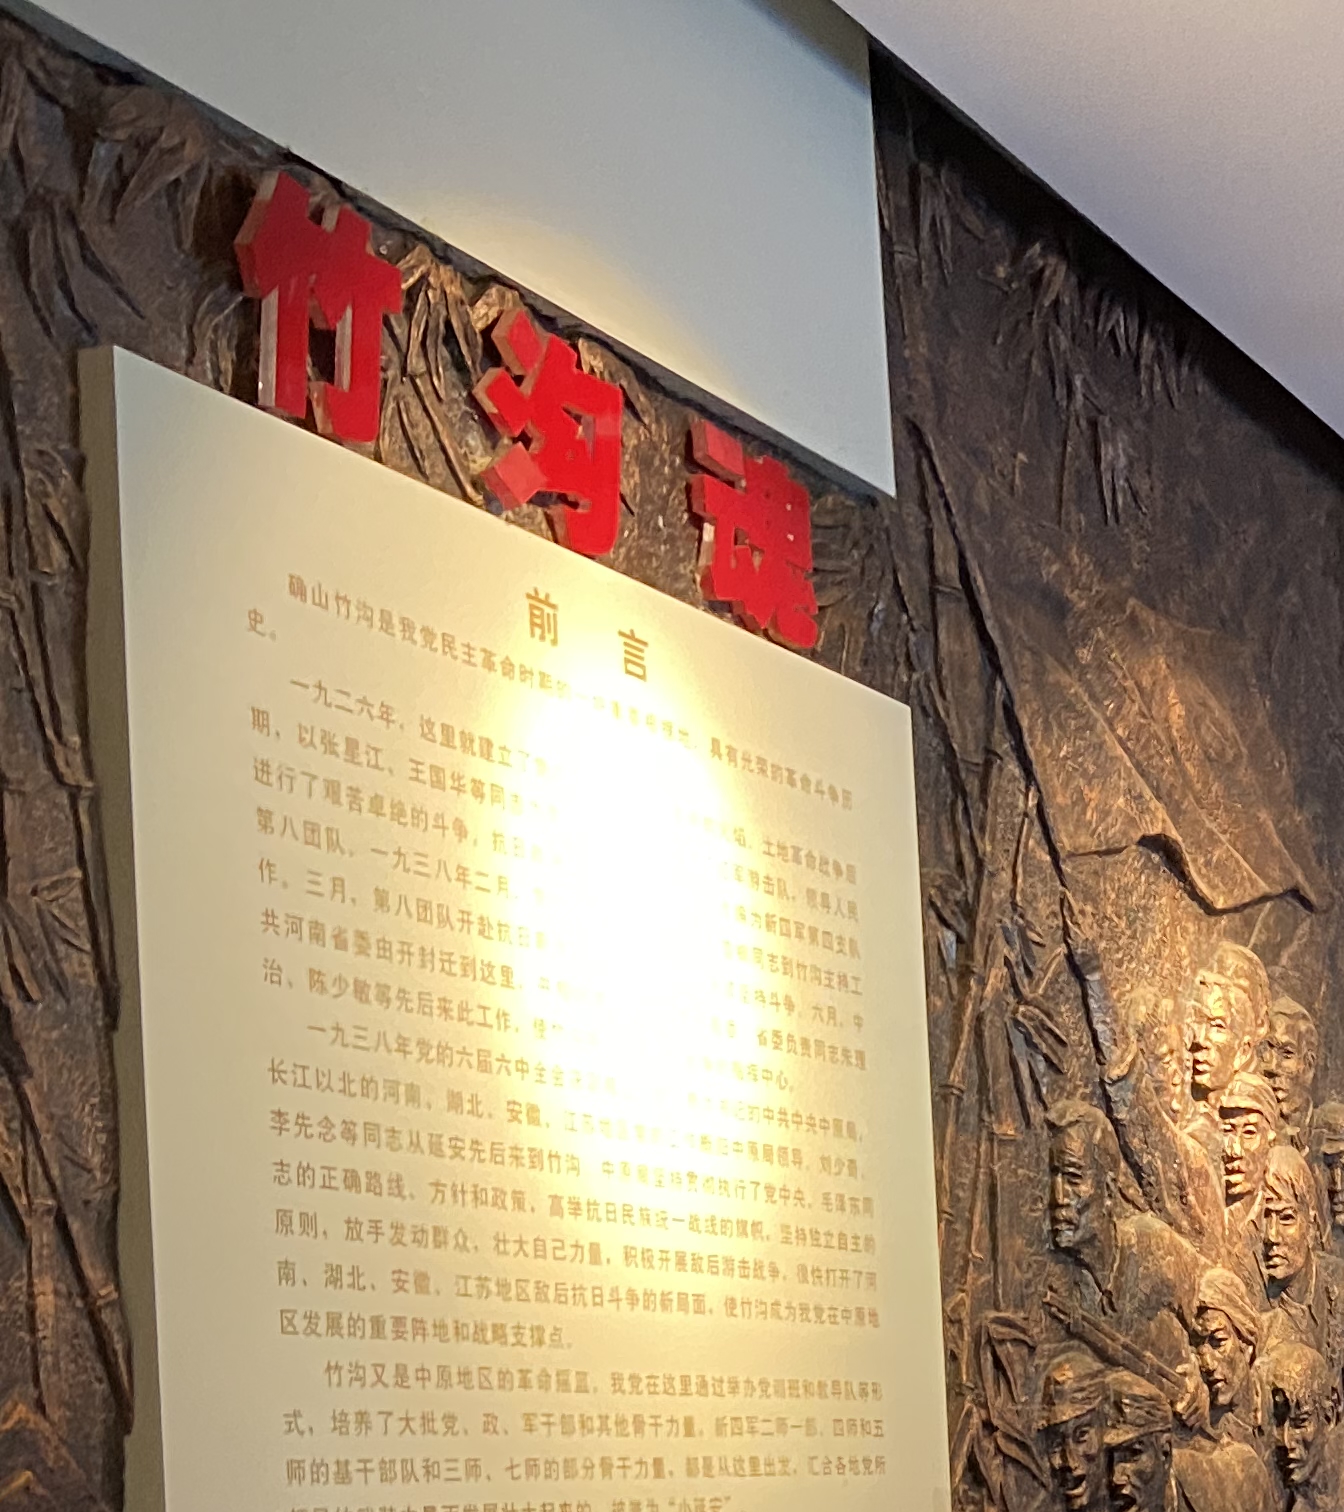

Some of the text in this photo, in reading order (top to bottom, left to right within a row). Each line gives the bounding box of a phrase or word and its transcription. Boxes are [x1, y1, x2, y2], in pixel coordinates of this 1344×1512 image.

[237, 172, 818, 648] 竹沟魂
[246, 605, 276, 642] 史。
[525, 586, 650, 683] 前言
